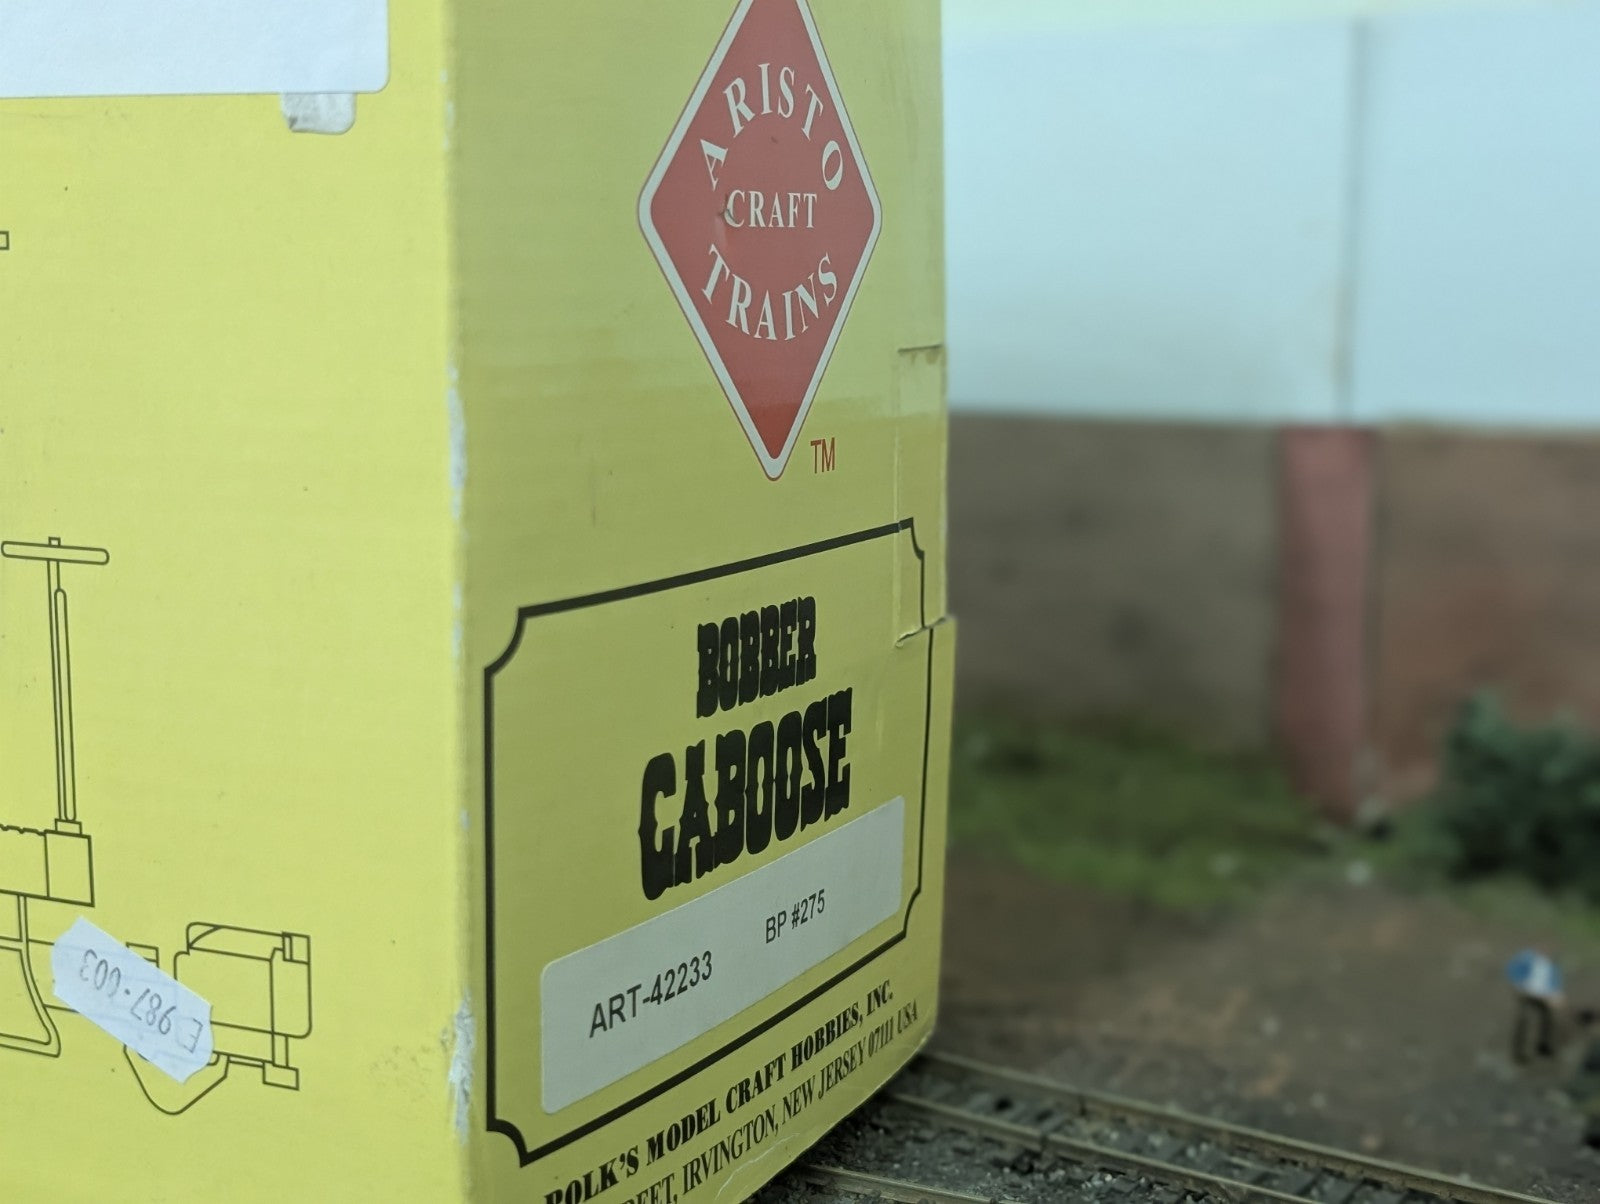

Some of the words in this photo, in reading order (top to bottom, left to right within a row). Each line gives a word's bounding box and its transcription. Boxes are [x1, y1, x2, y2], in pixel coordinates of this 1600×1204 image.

[700, 63, 843, 190] ARISTO
[725, 190, 817, 228] CRAFT
[701, 244, 837, 341] TRAINS
[810, 437, 836, 474] TM
[697, 596, 817, 719] BOBBER
[638, 687, 853, 900] CABOOSE
[589, 950, 713, 1038] ART-42233
[765, 910, 787, 944] BP
[791, 889, 825, 929] #275
[646, 1098, 721, 1166] MODEL
[726, 1053, 787, 1113] CRAFT
[791, 1002, 864, 1071] HOBBIES,
[867, 979, 894, 1016] INC.
[683, 1104, 779, 1195] IRVINGTON,
[782, 1075, 816, 1125] NEW
[818, 1036, 866, 1099] JERSEY
[868, 1016, 894, 1059] 07111
[897, 999, 919, 1035] USA
